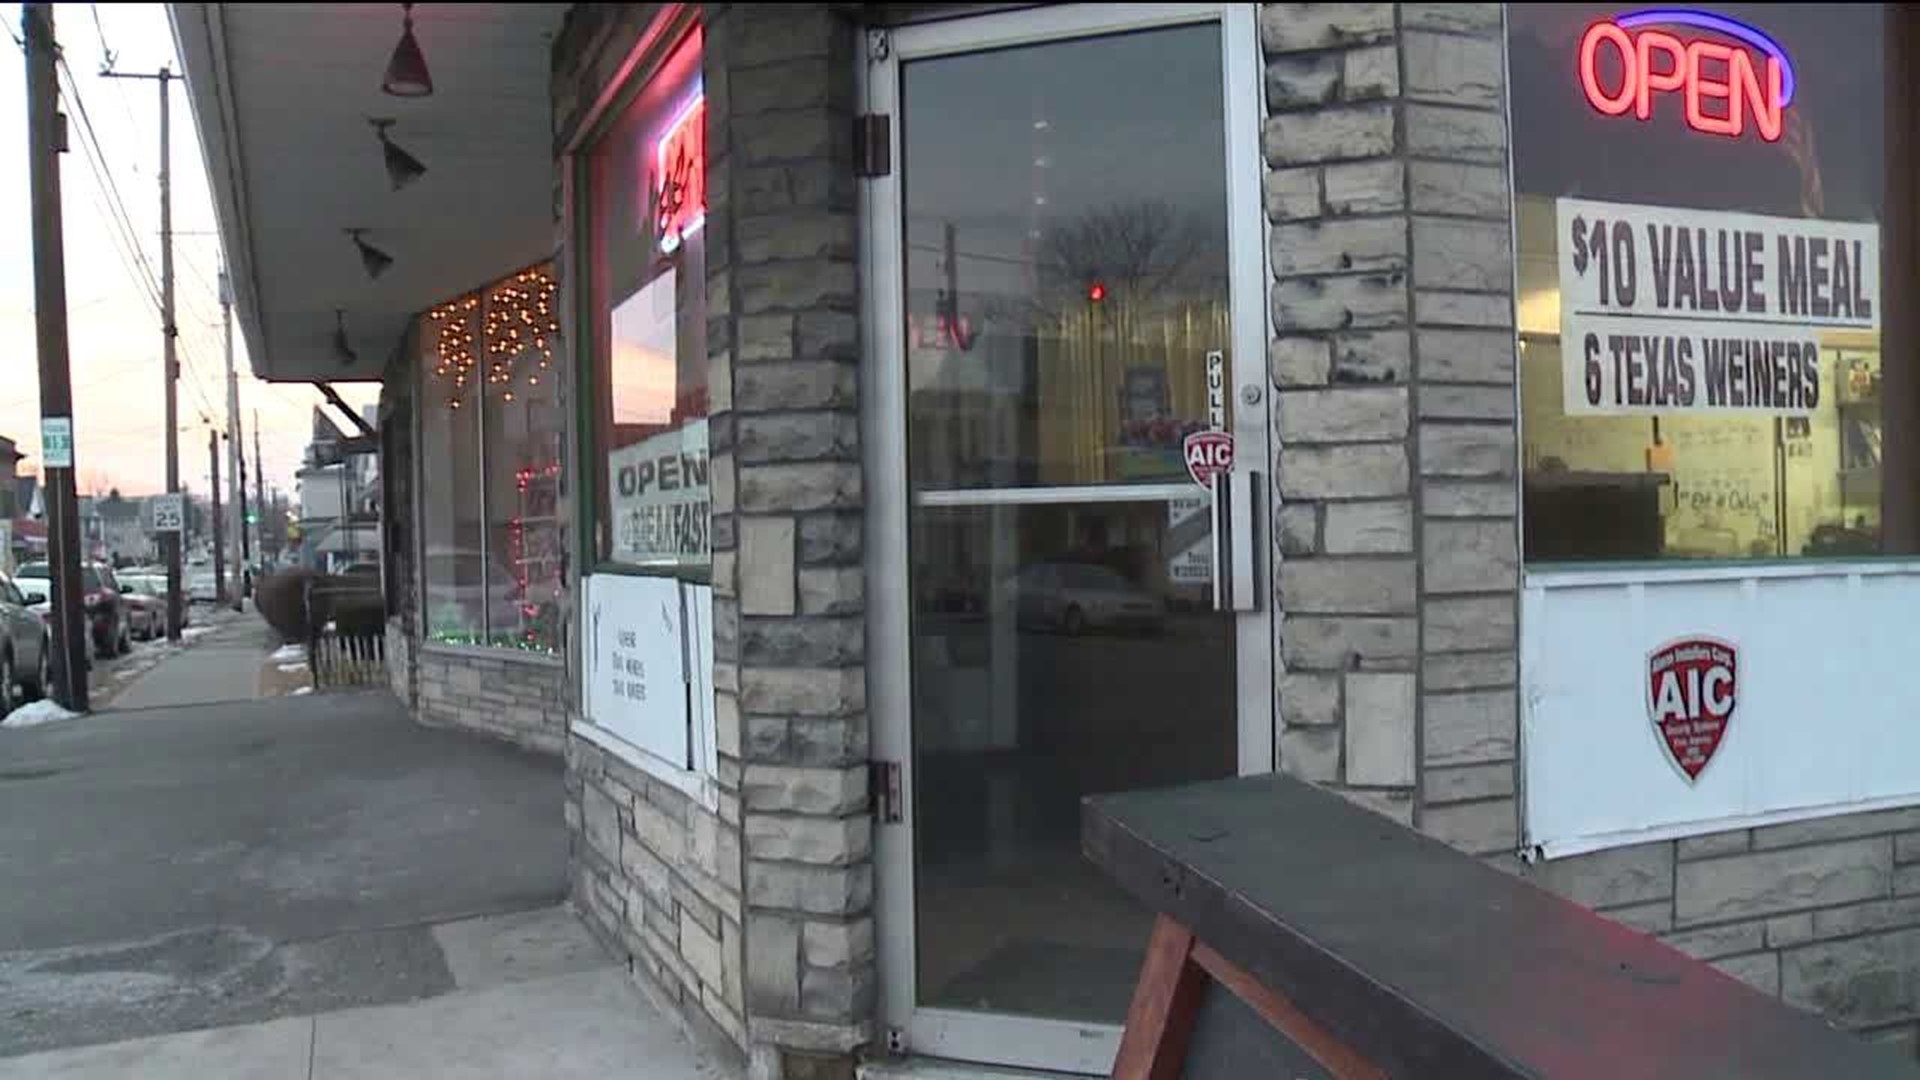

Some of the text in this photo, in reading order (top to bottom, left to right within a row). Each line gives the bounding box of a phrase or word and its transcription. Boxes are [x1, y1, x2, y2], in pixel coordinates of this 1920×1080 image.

[1580, 21, 1783, 141] OPEN
[1571, 215, 1872, 319] $10 VALUE MEAL
[1209, 355, 1221, 427] PULL
[1584, 332, 1819, 409] 6 TEXAS WEINERS
[618, 452, 708, 497] OPEN
[1189, 443, 1231, 466] AIC
[156, 512, 180, 527] 25
[1654, 664, 1733, 723] AIC
